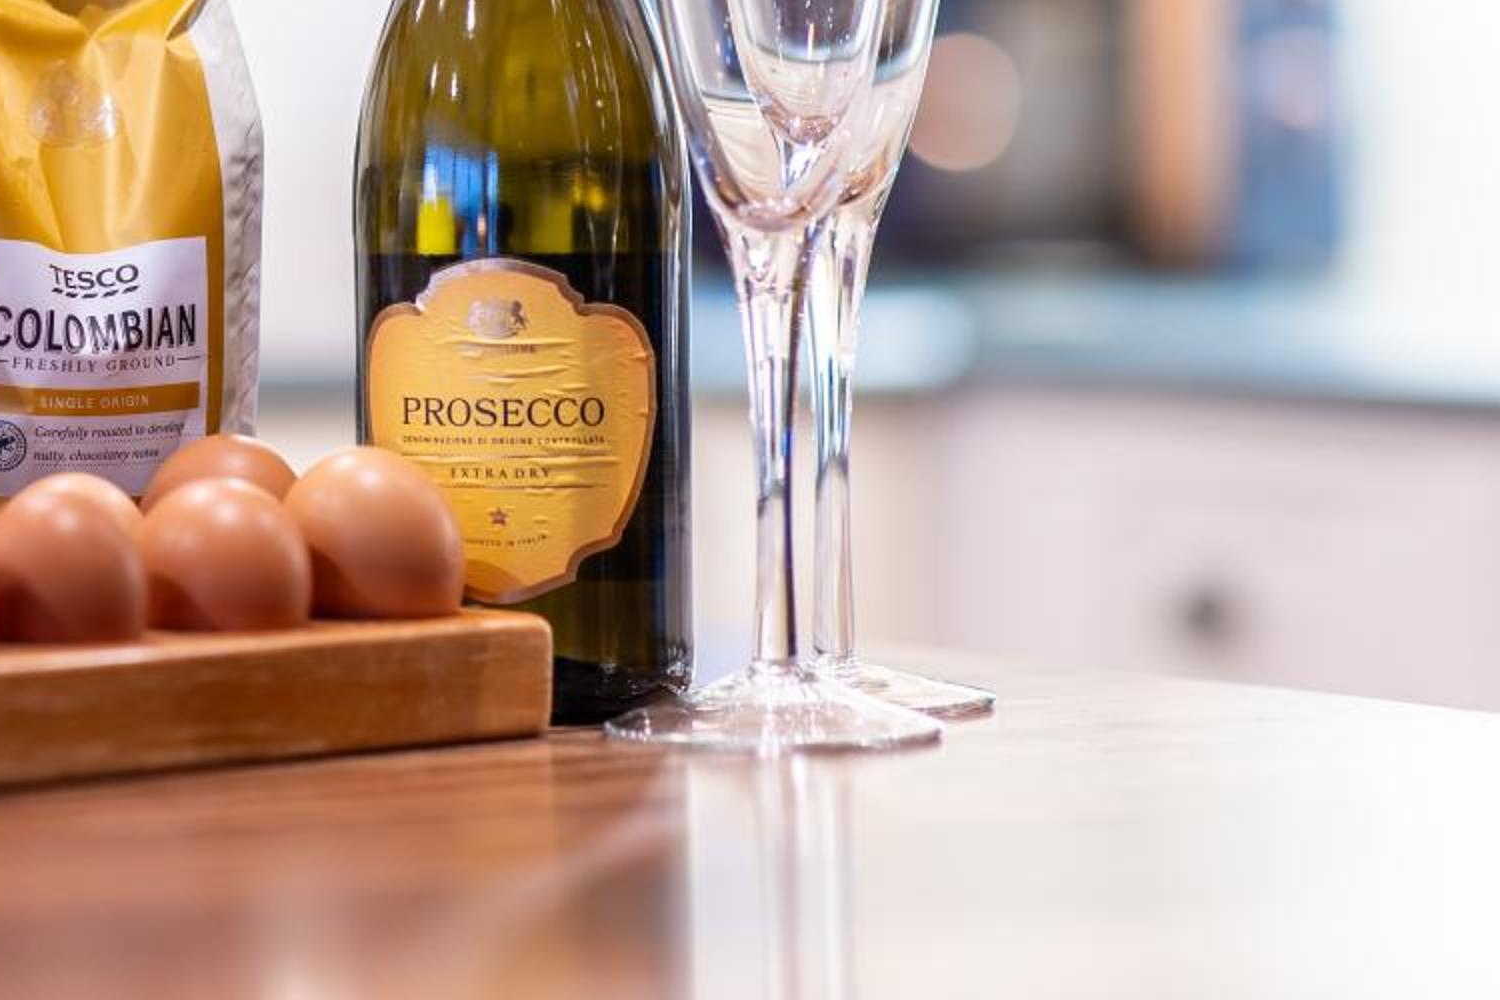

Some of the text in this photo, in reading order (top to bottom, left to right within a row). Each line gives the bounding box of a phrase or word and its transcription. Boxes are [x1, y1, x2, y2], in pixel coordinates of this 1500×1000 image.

[49, 263, 140, 290] TESCO
[11, 356, 176, 373] FRESHLY GROUND
[37, 393, 150, 410] SINGLE ORIGIN
[401, 396, 606, 428] PROSECCO
[34, 424, 90, 439] Carefully
[91, 425, 133, 438] roasted
[134, 425, 147, 437] to
[450, 466, 551, 480] EXTRA DRY
